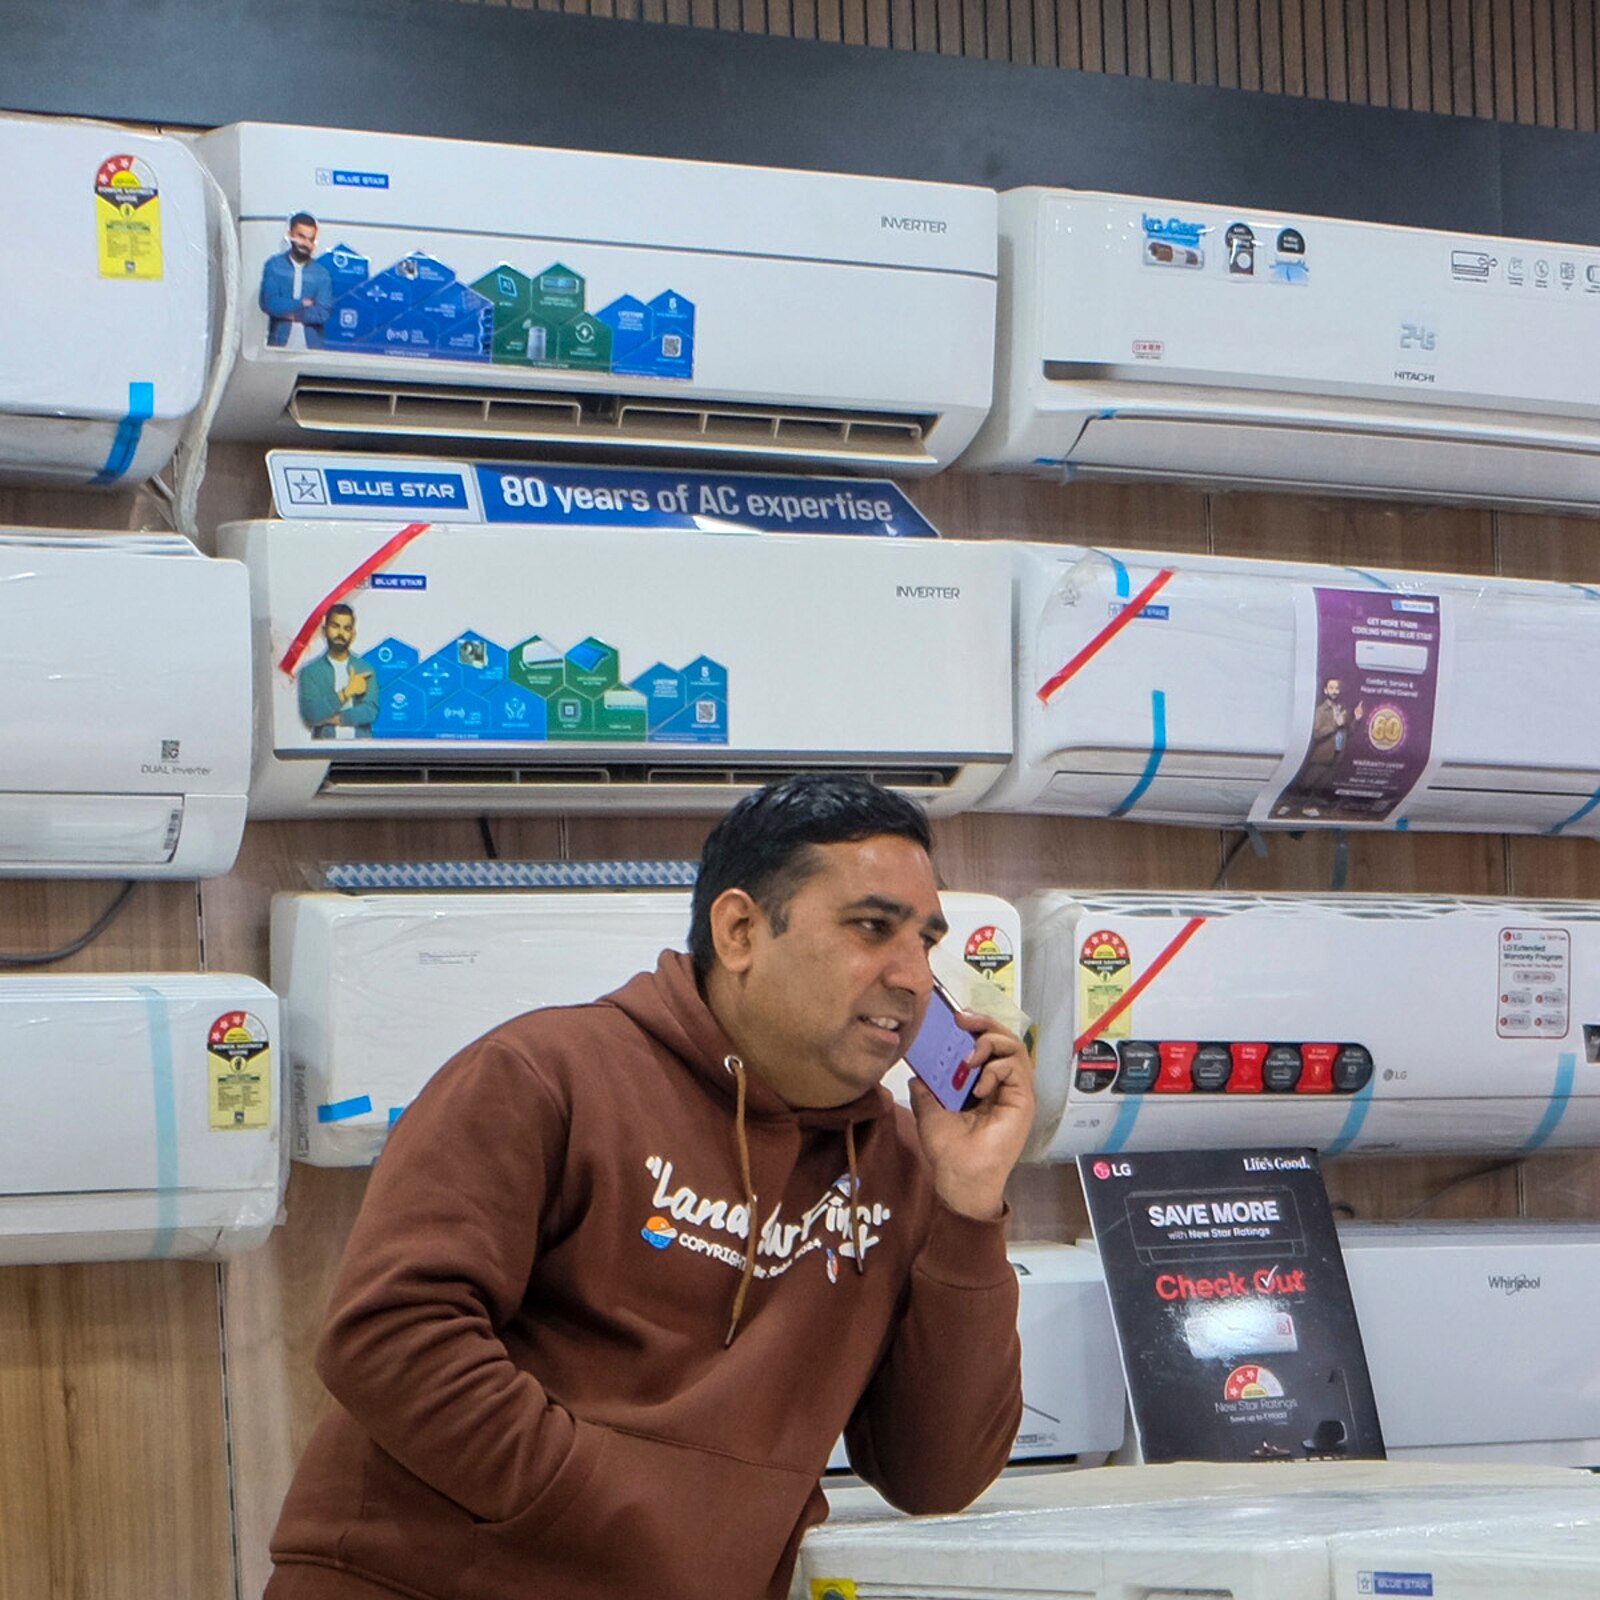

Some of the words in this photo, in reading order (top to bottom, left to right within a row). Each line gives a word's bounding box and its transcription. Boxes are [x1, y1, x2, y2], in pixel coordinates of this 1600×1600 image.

[880, 215, 948, 234] INVERTER
[1394, 370, 1436, 383] HITACHI
[336, 478, 396, 498] BLUE
[400, 480, 457, 501] STAR
[502, 475, 548, 509] 80
[553, 484, 651, 514] years
[656, 480, 690, 513] of
[698, 483, 740, 517] AC
[746, 486, 893, 526] expertise
[374, 577, 399, 588] BLUE
[895, 585, 959, 600] INVERTER
[1513, 944, 1546, 952] Extended
[1503, 953, 1534, 962] Warranty
[1534, 953, 1564, 963] Program
[1112, 1162, 1133, 1177] LG
[1148, 1203, 1210, 1228] SAVE
[1213, 1200, 1281, 1225] MORE
[1167, 1230, 1187, 1241] with
[1187, 1229, 1209, 1240] New
[1210, 1228, 1232, 1239] Star
[1232, 1227, 1271, 1239] Ratings
[1155, 1272, 1249, 1301] Check
[1253, 1268, 1307, 1296] Out
[1487, 1275, 1541, 1292] Whirlpool
[1214, 1401, 1236, 1413] New
[1237, 1401, 1259, 1412] Star
[1376, 1577, 1403, 1591] BLUE
[1405, 1577, 1431, 1591] STAR
